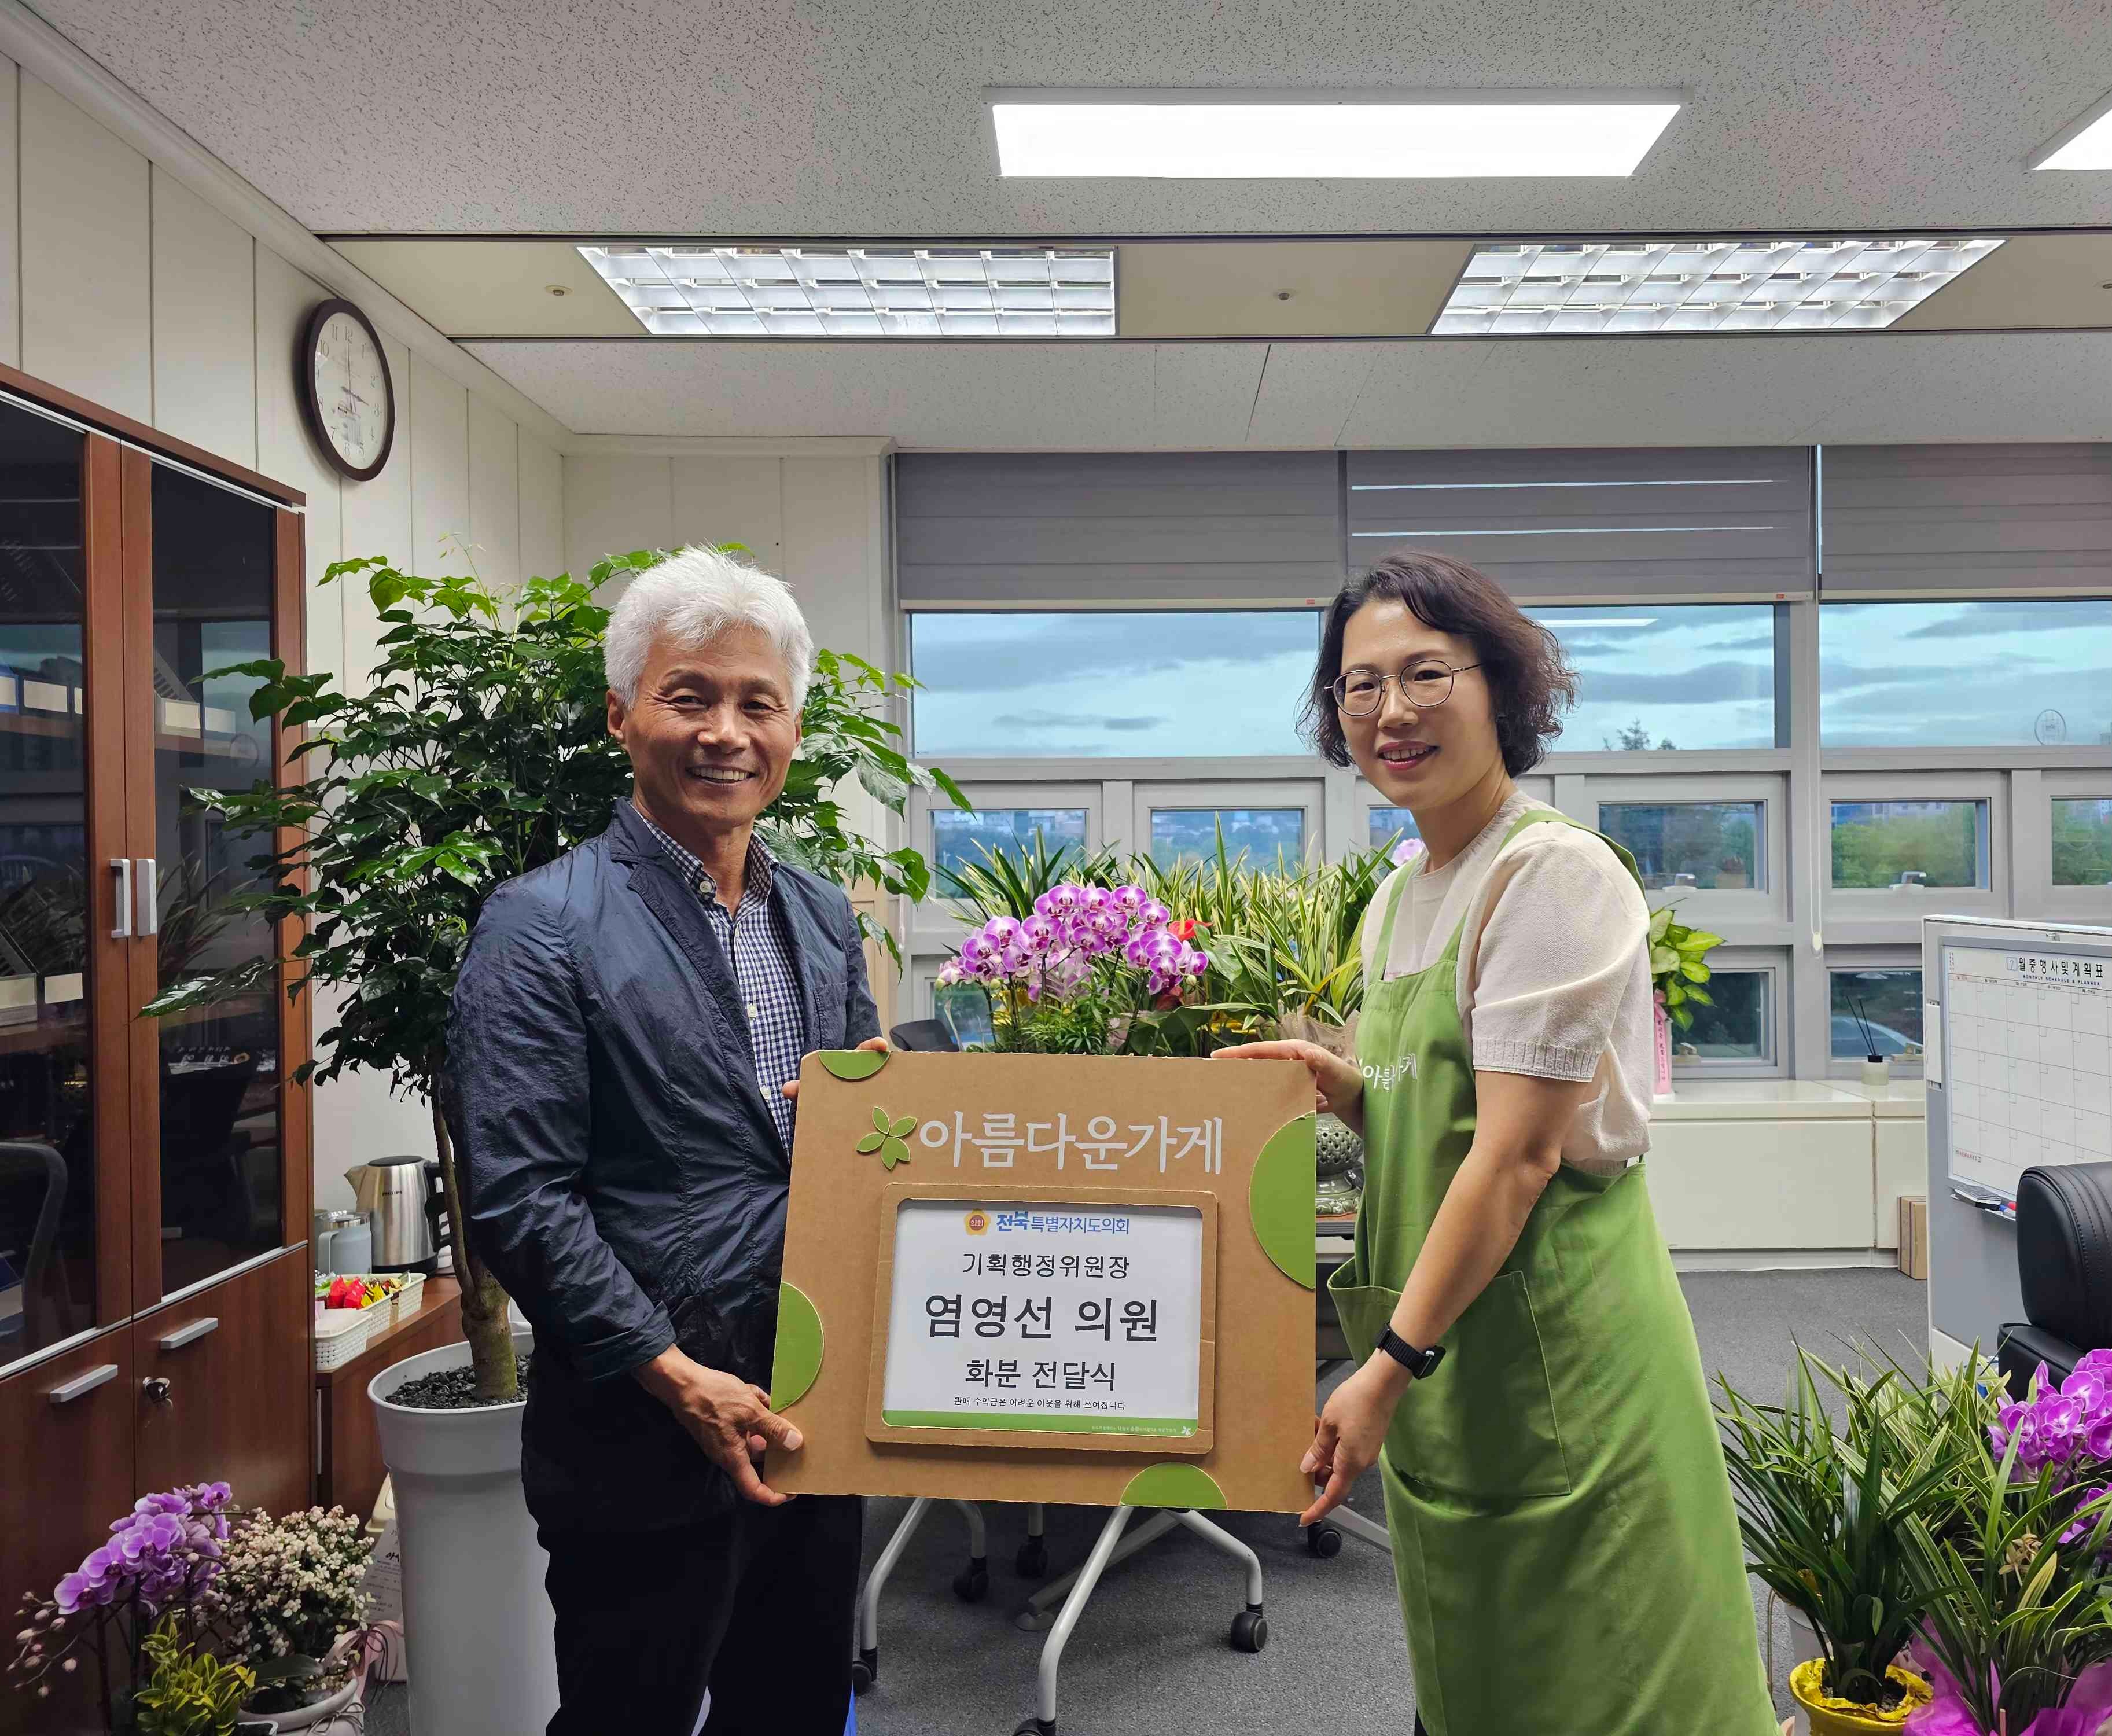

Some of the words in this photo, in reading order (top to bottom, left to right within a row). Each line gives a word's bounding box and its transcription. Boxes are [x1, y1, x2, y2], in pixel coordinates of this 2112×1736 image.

[320, 339, 329, 358] 10
[2019, 957, 2104, 979] 월중행사및계획표
[919, 1110, 1223, 1175] 아름다운가게
[962, 1253, 1130, 1279] 기획행정위원장
[925, 1294, 1052, 1339] 염영선
[1074, 1297, 1157, 1342] 의원
[965, 1359, 1021, 1388] 화분
[1032, 1360, 1116, 1391] 전달식
[954, 1397, 970, 1406] 판매
[973, 1397, 1007, 1407] 수익금은
[1009, 1398, 1035, 1407] 어려운
[1037, 1399, 1062, 1408] 이웃을
[1064, 1399, 1081, 1408] 위해
[1083, 1400, 1126, 1410] 쓰여집니다
